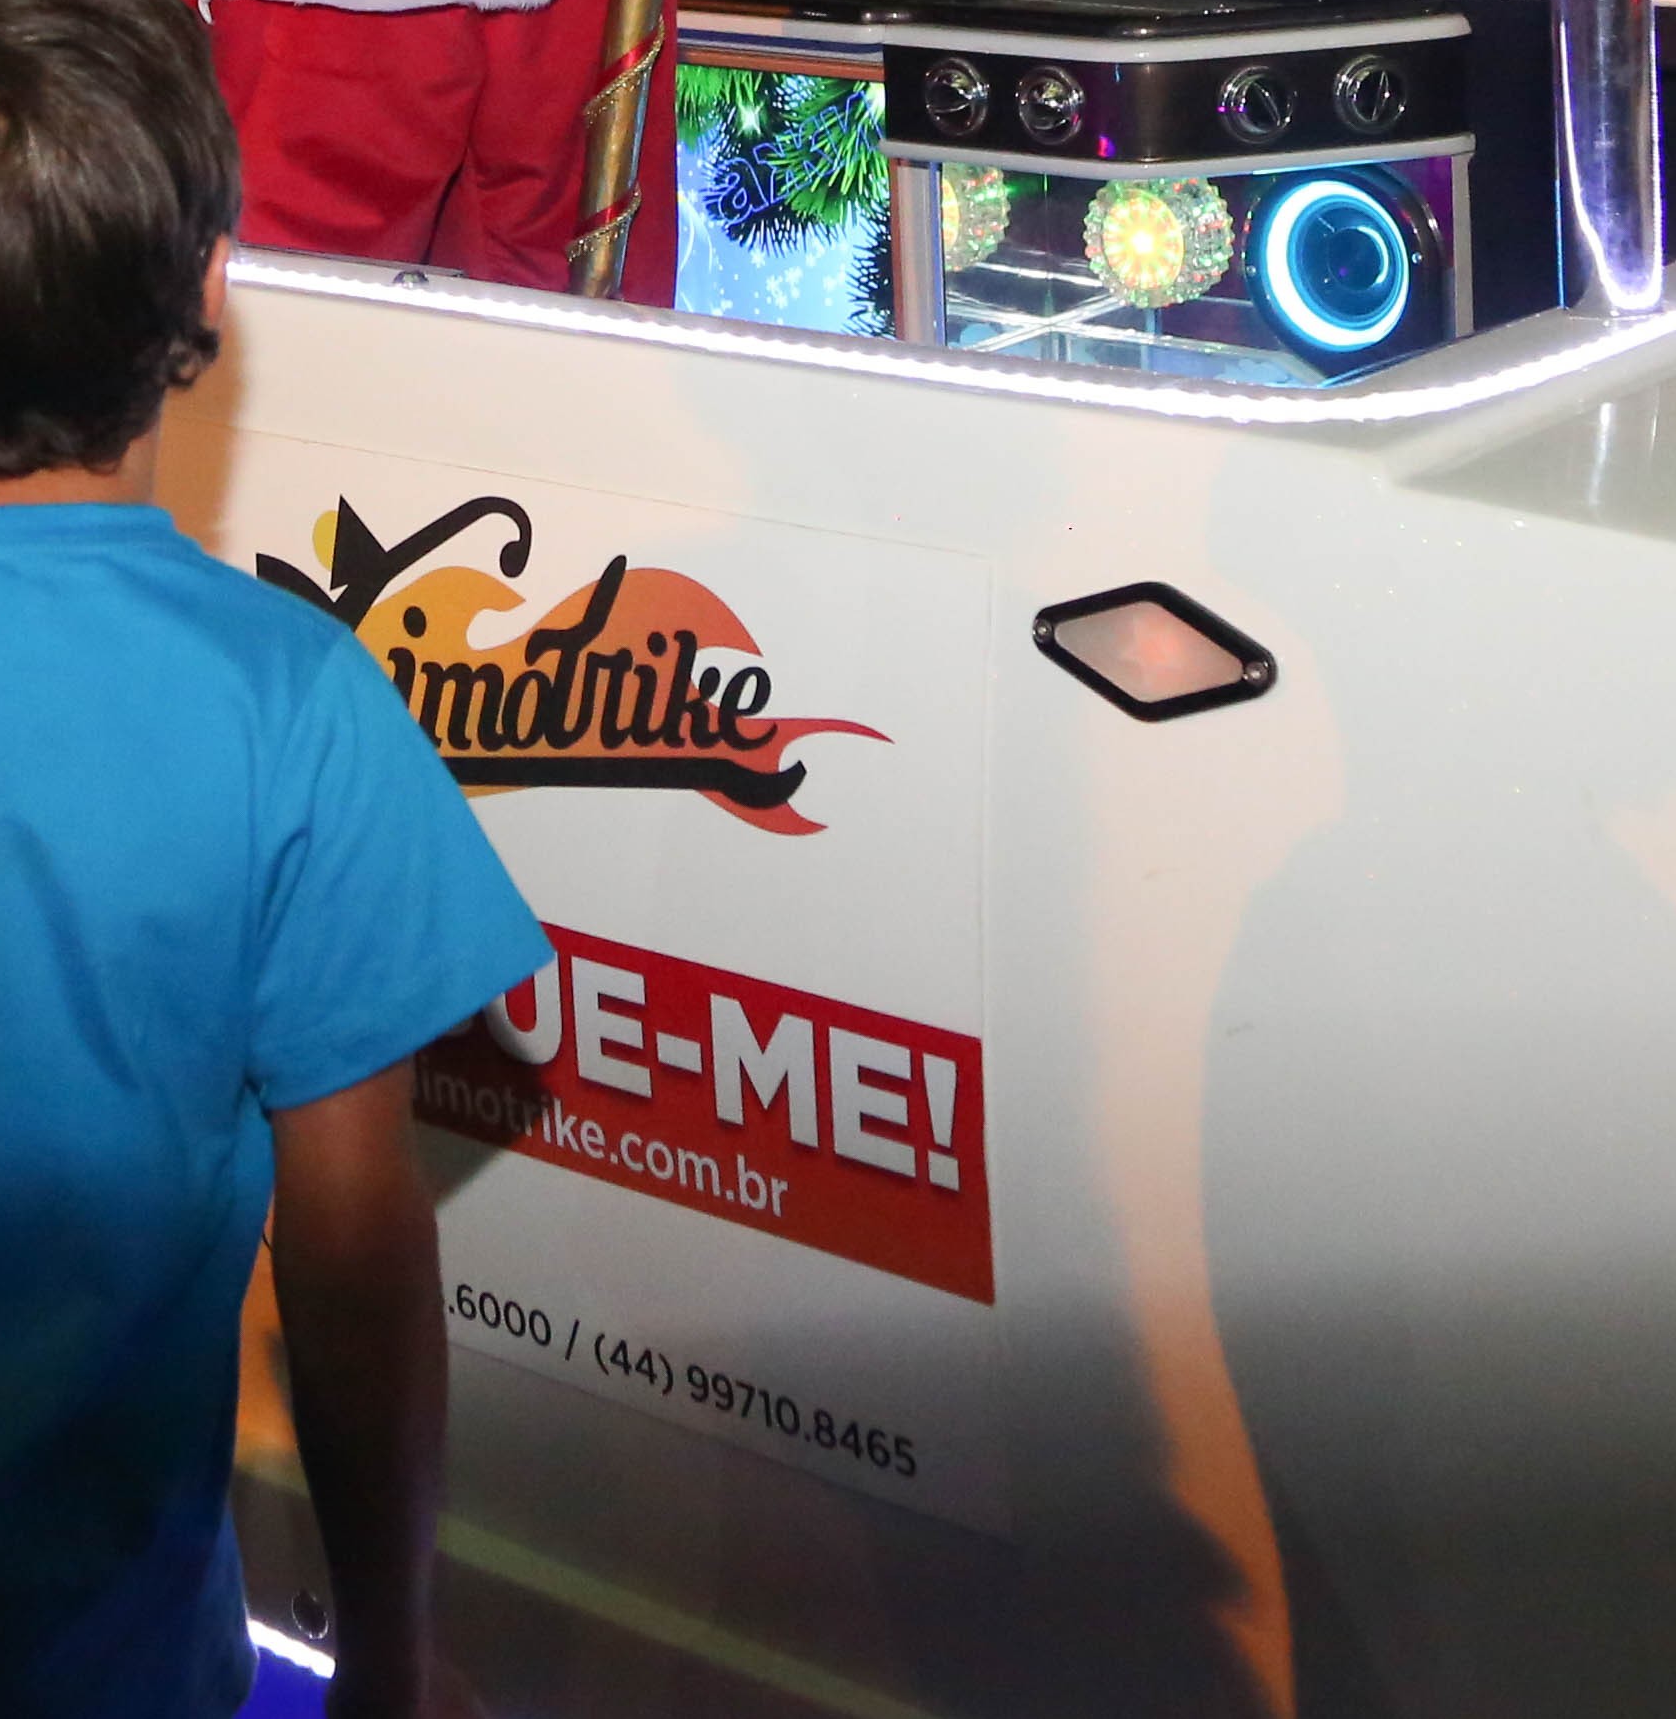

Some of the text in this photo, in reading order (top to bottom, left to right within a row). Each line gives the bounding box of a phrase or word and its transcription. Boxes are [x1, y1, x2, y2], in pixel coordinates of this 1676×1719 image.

[450, 950, 961, 1194] UE-ME!
[594, 1332, 675, 1396] (44)
[686, 1364, 918, 1478] 99710.8465
